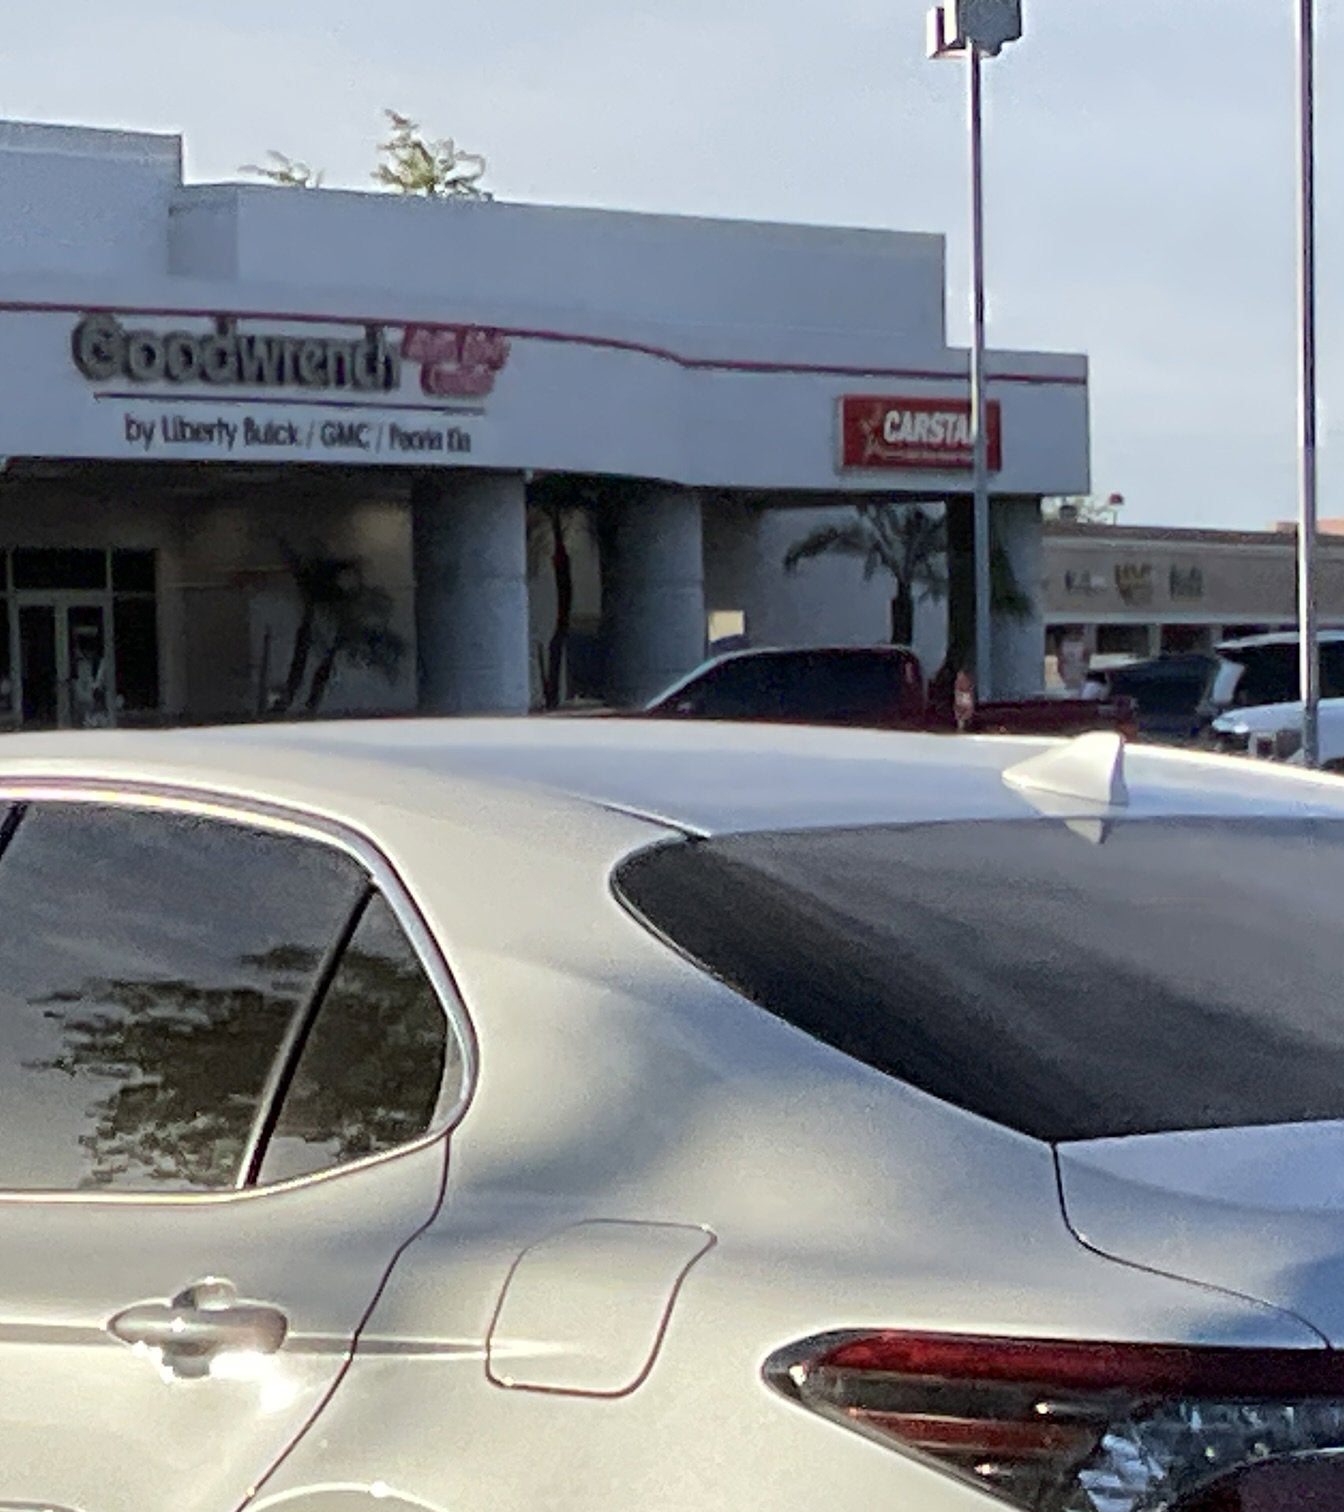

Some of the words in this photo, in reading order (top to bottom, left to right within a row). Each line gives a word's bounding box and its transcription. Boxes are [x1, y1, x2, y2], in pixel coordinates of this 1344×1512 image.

[125, 412, 155, 451] by
[162, 414, 237, 451] Liberty
[243, 416, 298, 447] Buick
[320, 420, 370, 450] GMC
[884, 410, 976, 447] CARSTA
